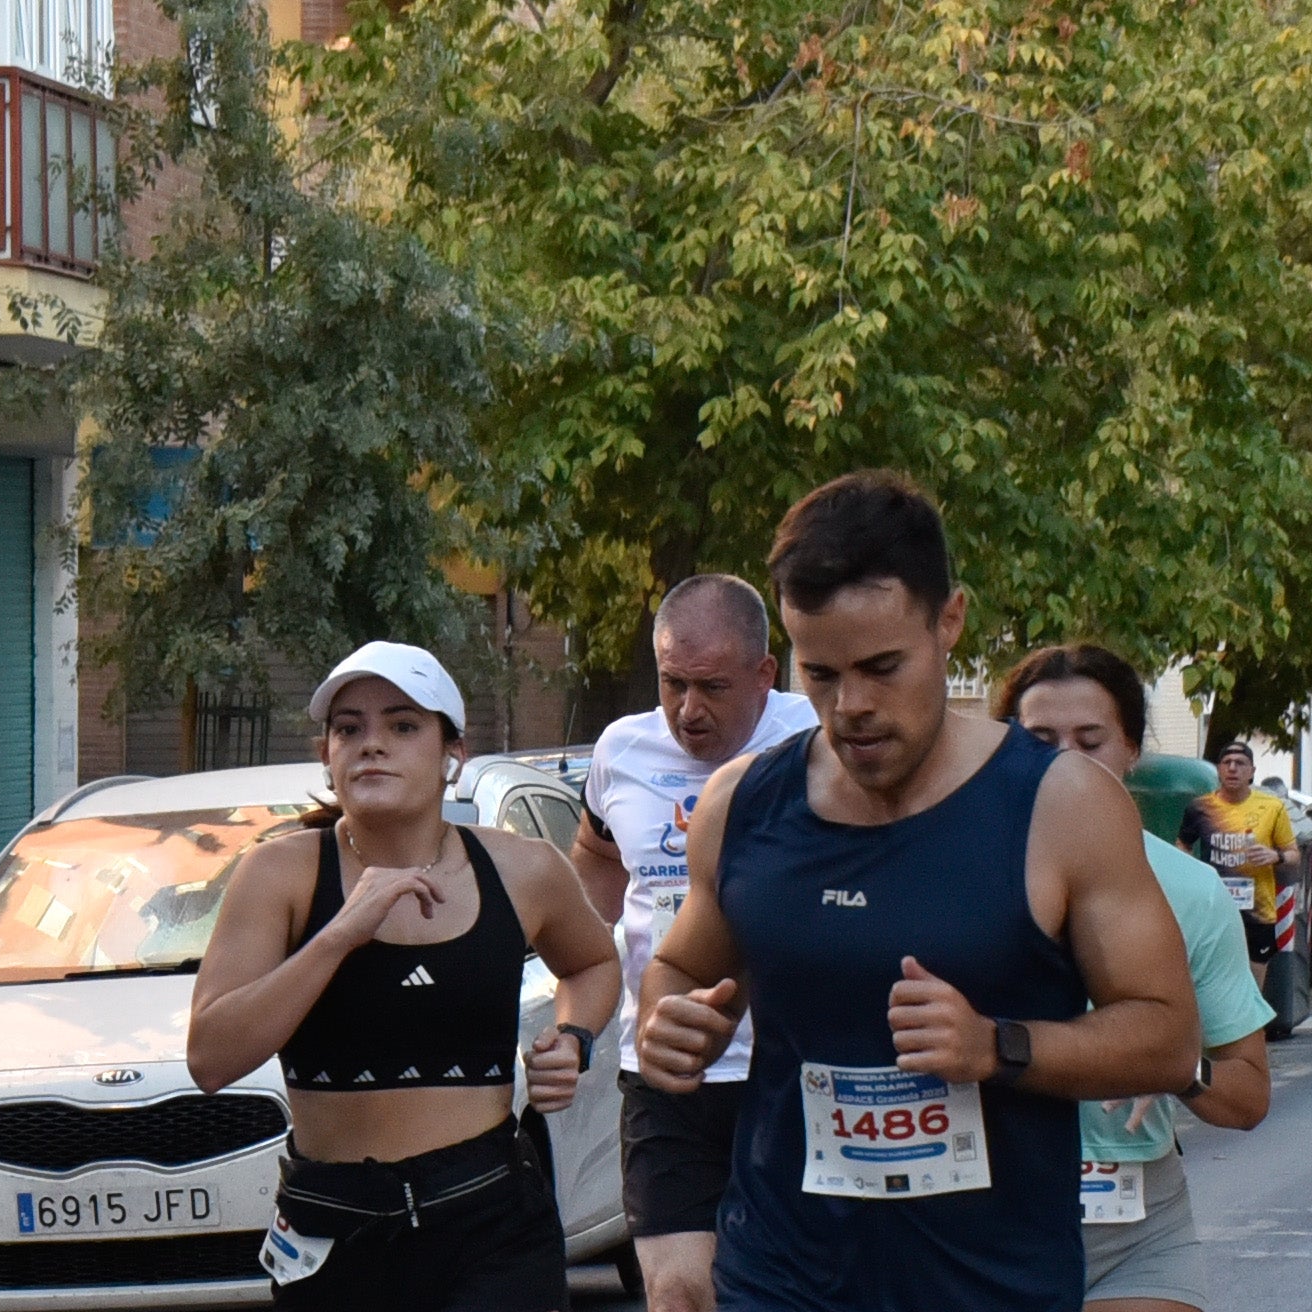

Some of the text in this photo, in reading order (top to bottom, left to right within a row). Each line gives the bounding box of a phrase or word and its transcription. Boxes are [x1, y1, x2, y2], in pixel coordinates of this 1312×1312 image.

[638, 864, 690, 877] CARRE
[821, 889, 867, 906] FILA
[102, 1071, 135, 1082] KIA
[831, 1104, 950, 1141] 1486
[38, 1188, 211, 1228] 6915 JFD
